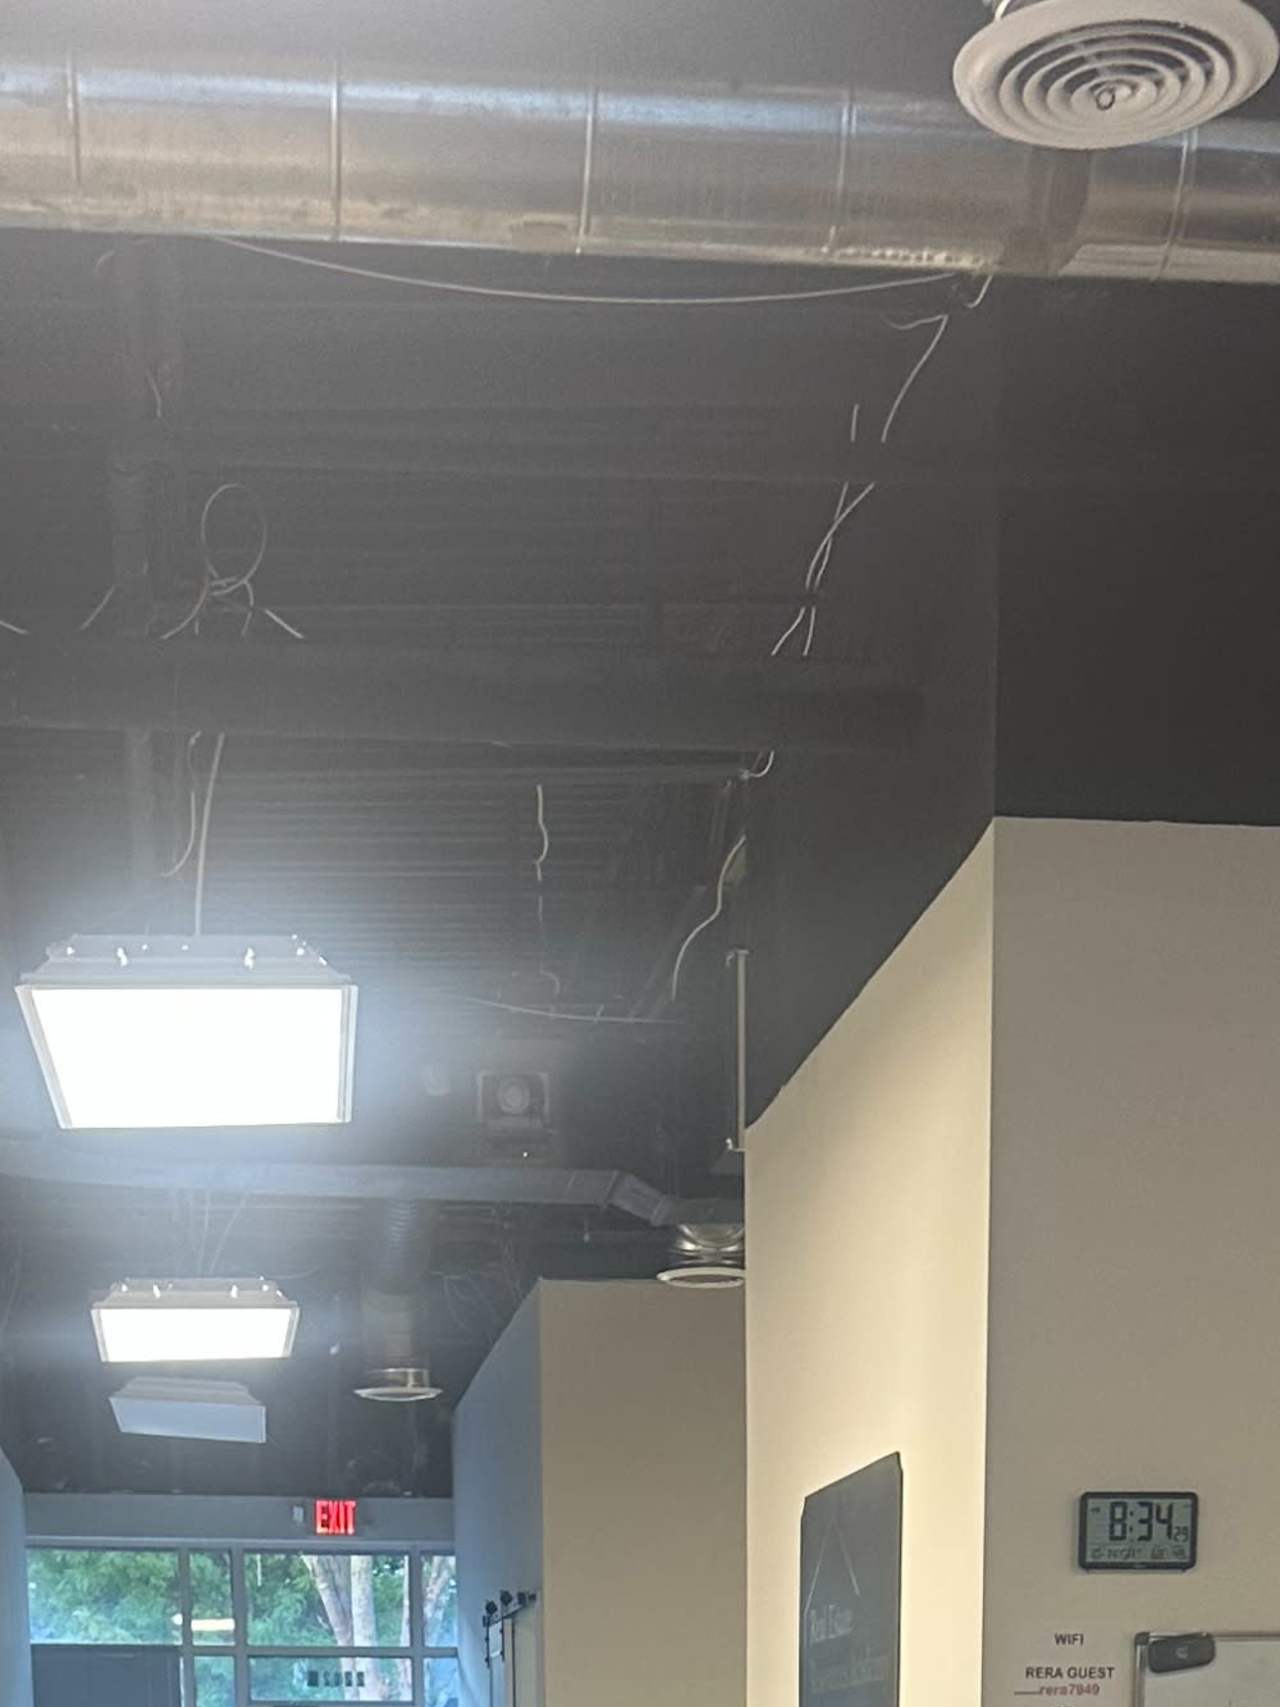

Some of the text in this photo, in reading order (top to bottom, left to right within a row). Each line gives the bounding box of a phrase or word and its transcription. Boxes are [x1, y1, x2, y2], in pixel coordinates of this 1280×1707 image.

[316, 1500, 356, 1534] EXIT
[1109, 1501, 1173, 1541] 8:34
[1054, 1633, 1084, 1645] WIFI
[1025, 1666, 1115, 1679] RERA GUEST
